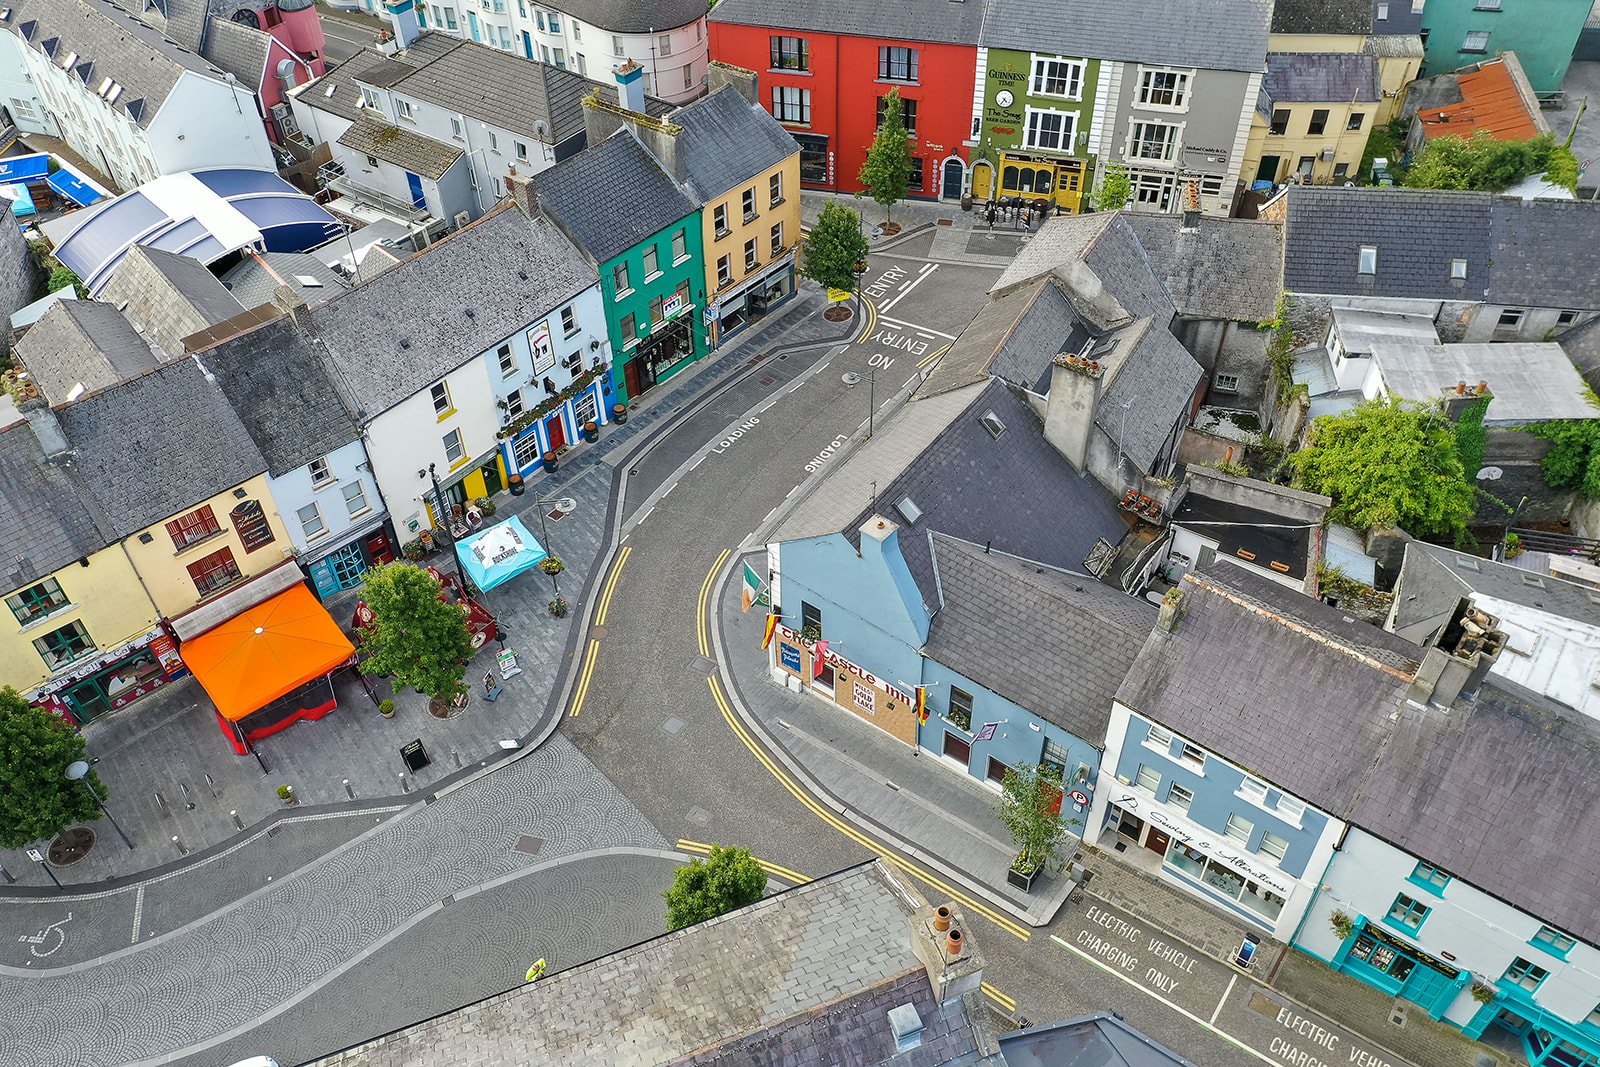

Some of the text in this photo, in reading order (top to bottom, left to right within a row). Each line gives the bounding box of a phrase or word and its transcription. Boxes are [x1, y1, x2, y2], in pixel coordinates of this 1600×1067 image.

[989, 69, 1025, 81] GUINNESS
[986, 108, 1021, 120] The Snug
[864, 265, 907, 298] ENTRY
[870, 330, 928, 355] ENTRY
[868, 354, 895, 370] NO
[712, 417, 760, 454] LOADING
[804, 434, 848, 473] LOADING
[854, 695, 874, 711] FLAKE
[855, 689, 872, 703] GOLD
[1150, 811, 1287, 893] Sewing & Alterations
[1086, 905, 1198, 974] ELECTRIC VEHICLE
[1077, 930, 1179, 993] CHARGING ONLY
[1276, 1006, 1339, 1051] ELECTRIC
